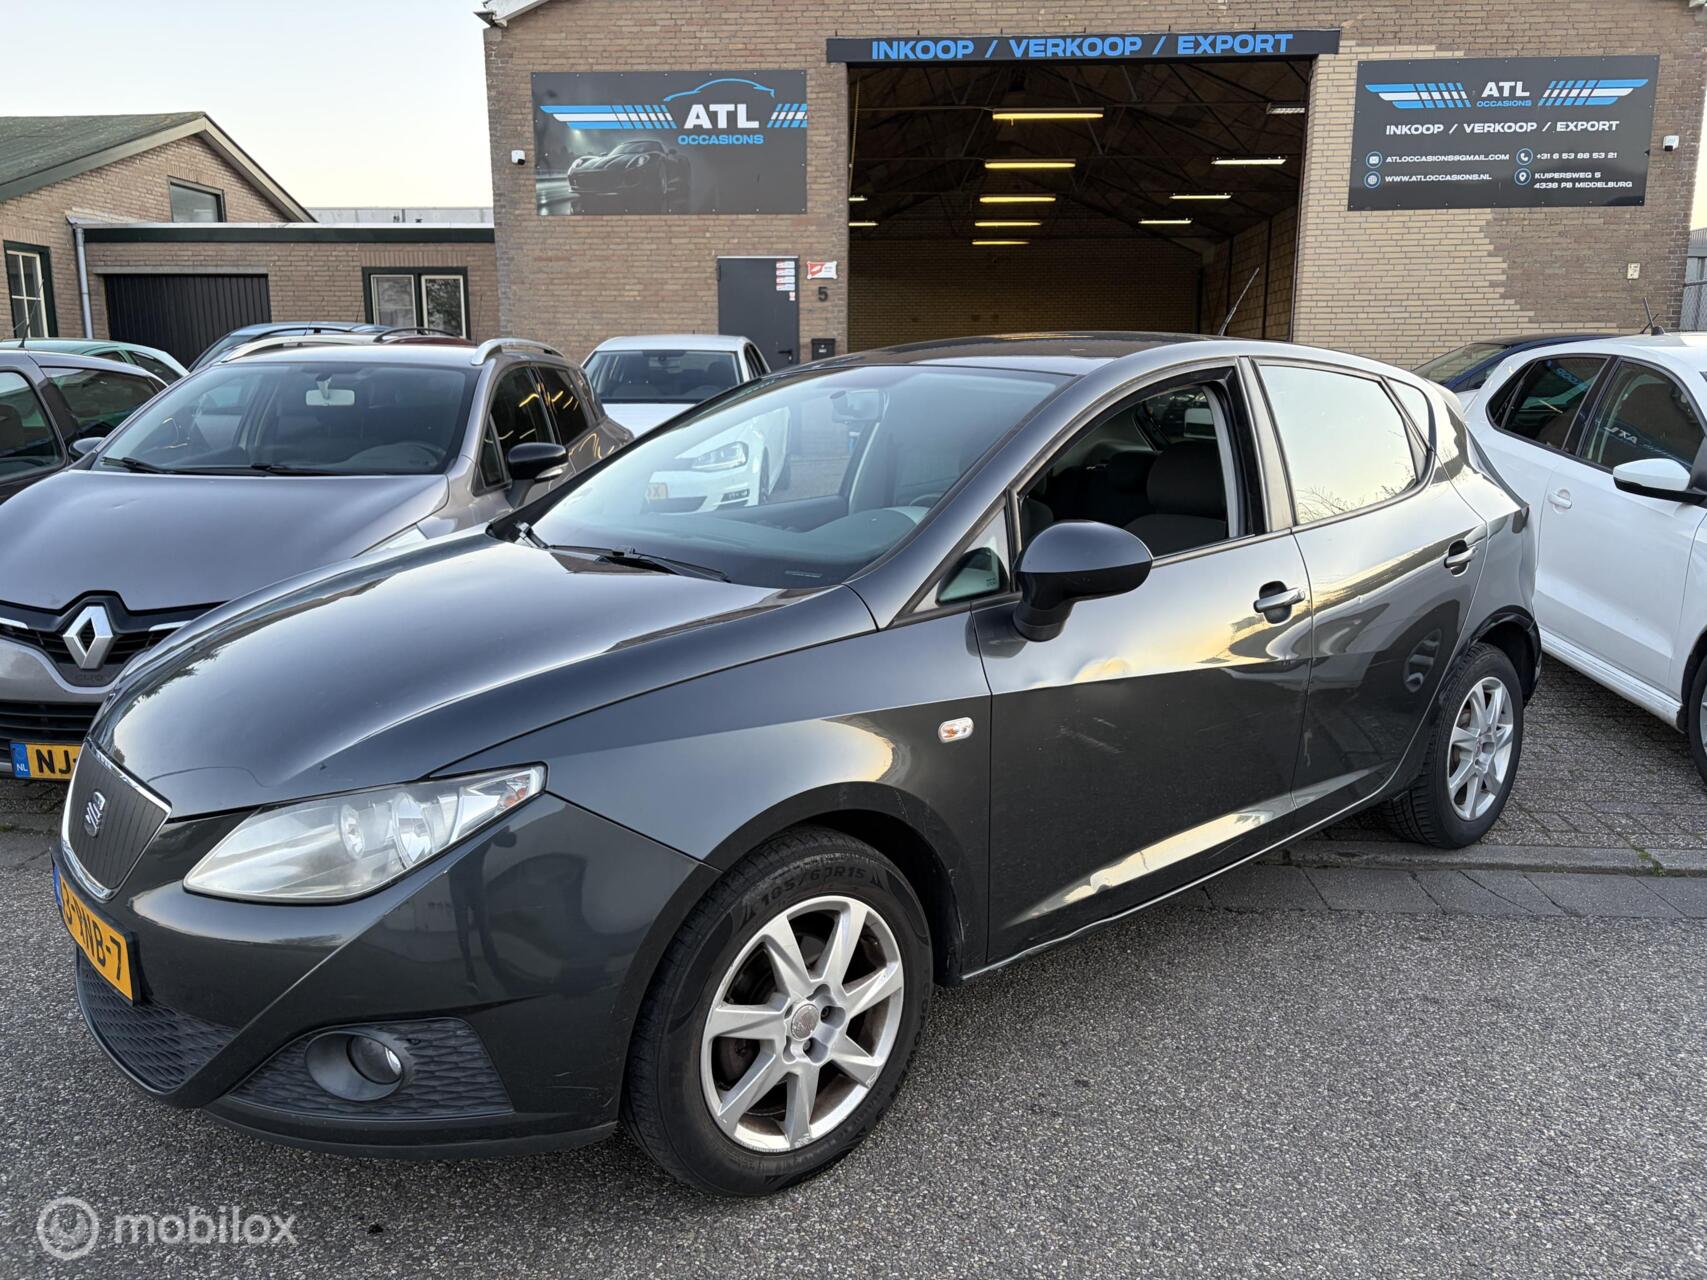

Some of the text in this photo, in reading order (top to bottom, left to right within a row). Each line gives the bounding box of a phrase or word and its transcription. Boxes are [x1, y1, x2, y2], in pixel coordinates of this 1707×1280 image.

[871, 33, 1294, 60] INKOOP / VERKOOP / EXPORT
[1481, 81, 1530, 98] ATL
[1476, 99, 1532, 108] OCCASIONS
[683, 103, 760, 129] ATL
[1385, 120, 1620, 136] INKOOP / VERKOOP / EXPORT
[677, 134, 764, 145] OCCASIONS
[1385, 174, 1492, 182] WWW.ATLOCCASIONS.NL
[818, 286, 828, 302] 5
[16, 762, 28, 772] NL
